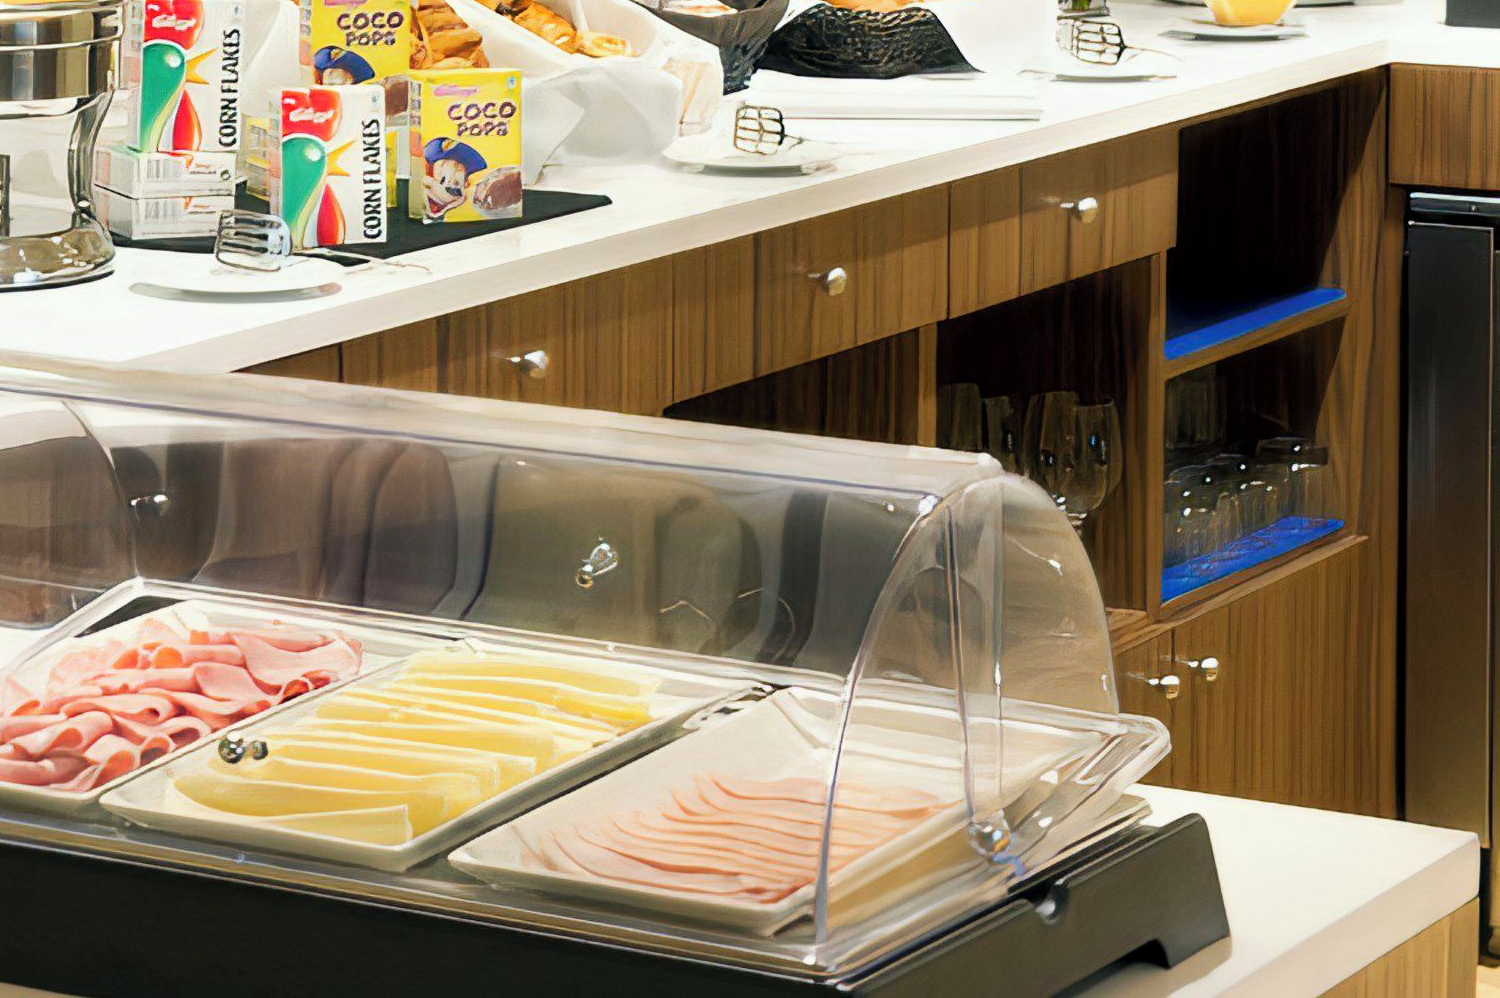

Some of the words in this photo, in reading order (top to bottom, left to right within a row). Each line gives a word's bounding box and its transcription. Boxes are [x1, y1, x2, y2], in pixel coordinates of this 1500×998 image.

[337, 11, 404, 30] COCO
[218, 99, 238, 148] CORN
[447, 101, 517, 120] COCO
[363, 189, 382, 240] CORN
